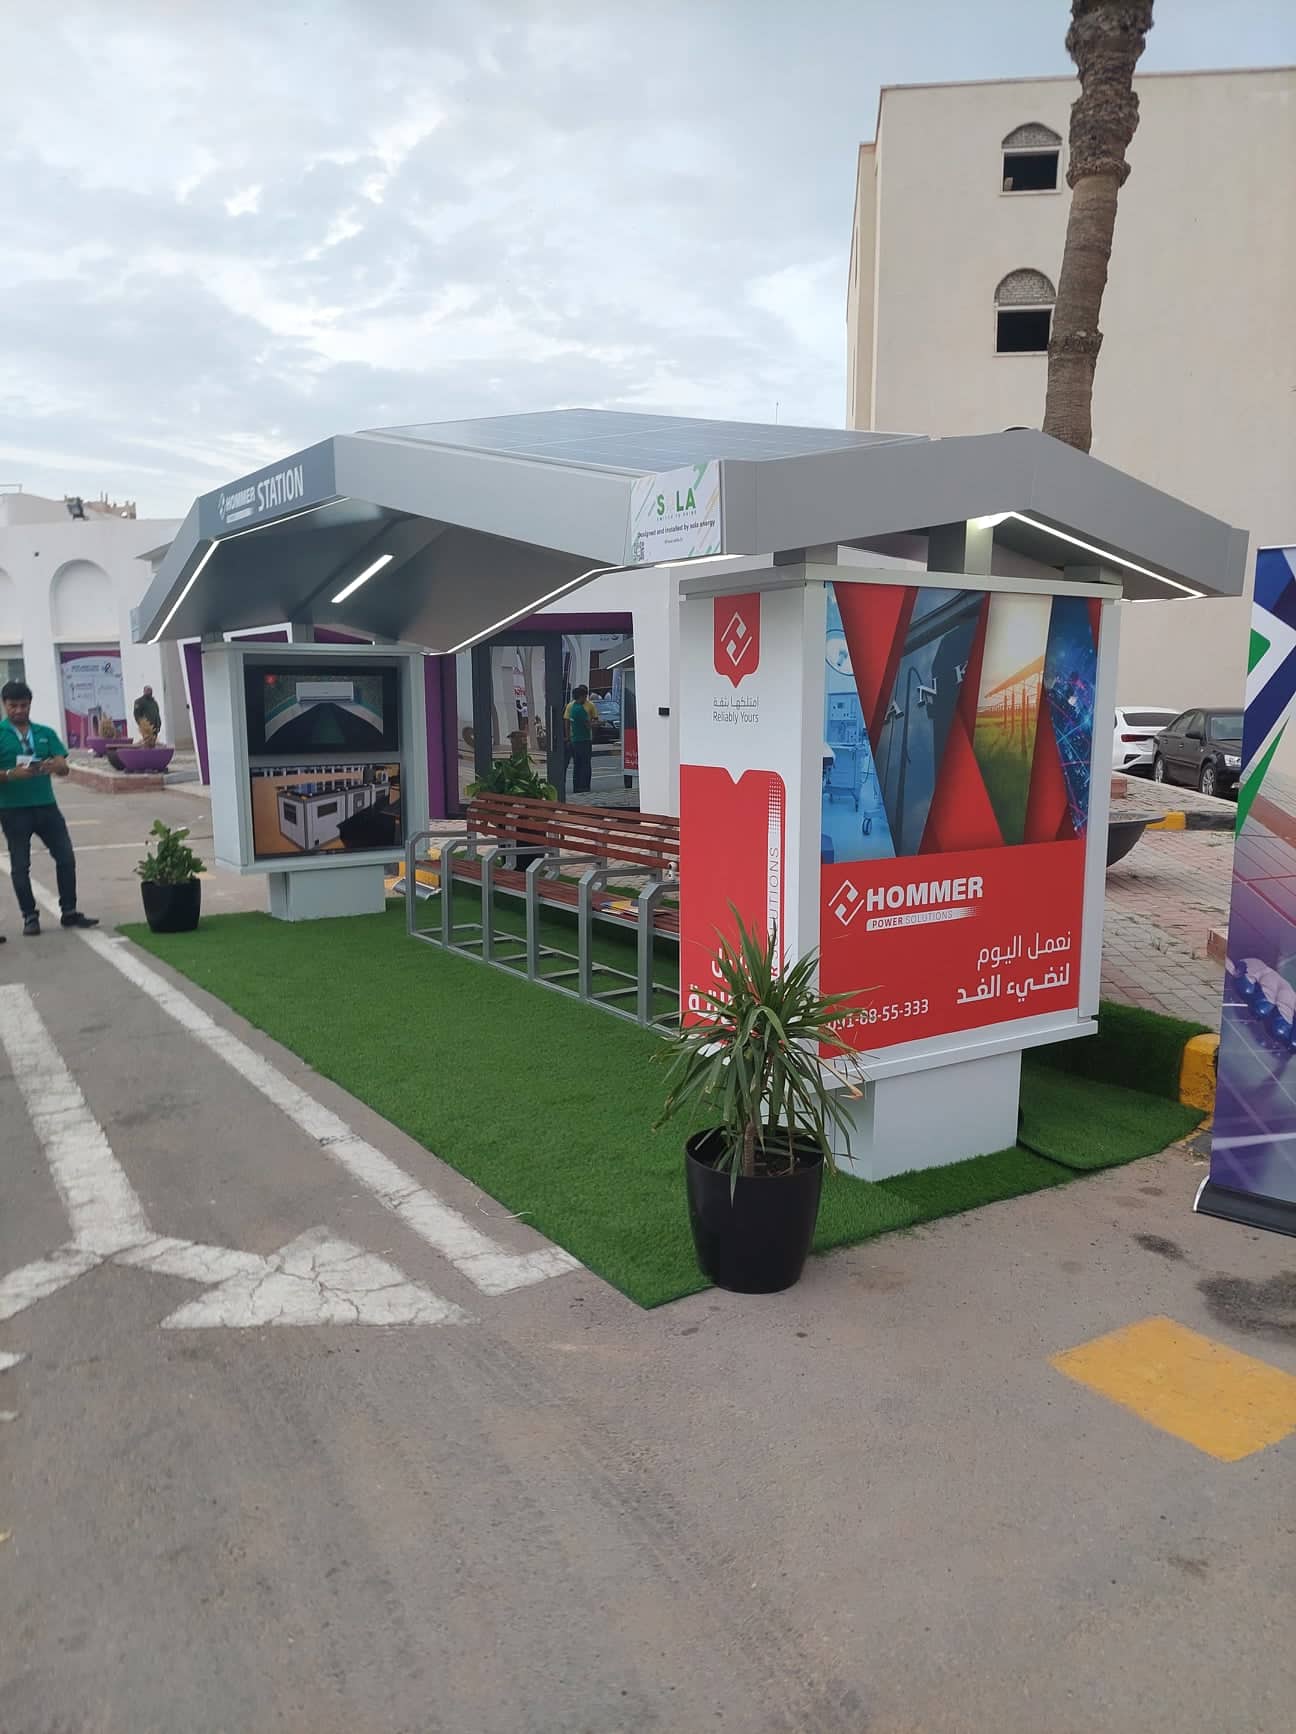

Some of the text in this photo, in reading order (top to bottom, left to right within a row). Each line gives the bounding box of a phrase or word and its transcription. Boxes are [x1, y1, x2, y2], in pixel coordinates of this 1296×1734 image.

[257, 464, 304, 512] STATION
[656, 487, 696, 516] SLA
[665, 525, 683, 534] installed
[700, 520, 716, 528] energy
[712, 711, 759, 725] Reliably Yours
[866, 876, 984, 912] HOMMER
[872, 911, 954, 929] POWER SOLUTIONS
[977, 931, 1071, 971] نعمل اليوم
[956, 963, 1070, 1004] لنضيء الغد
